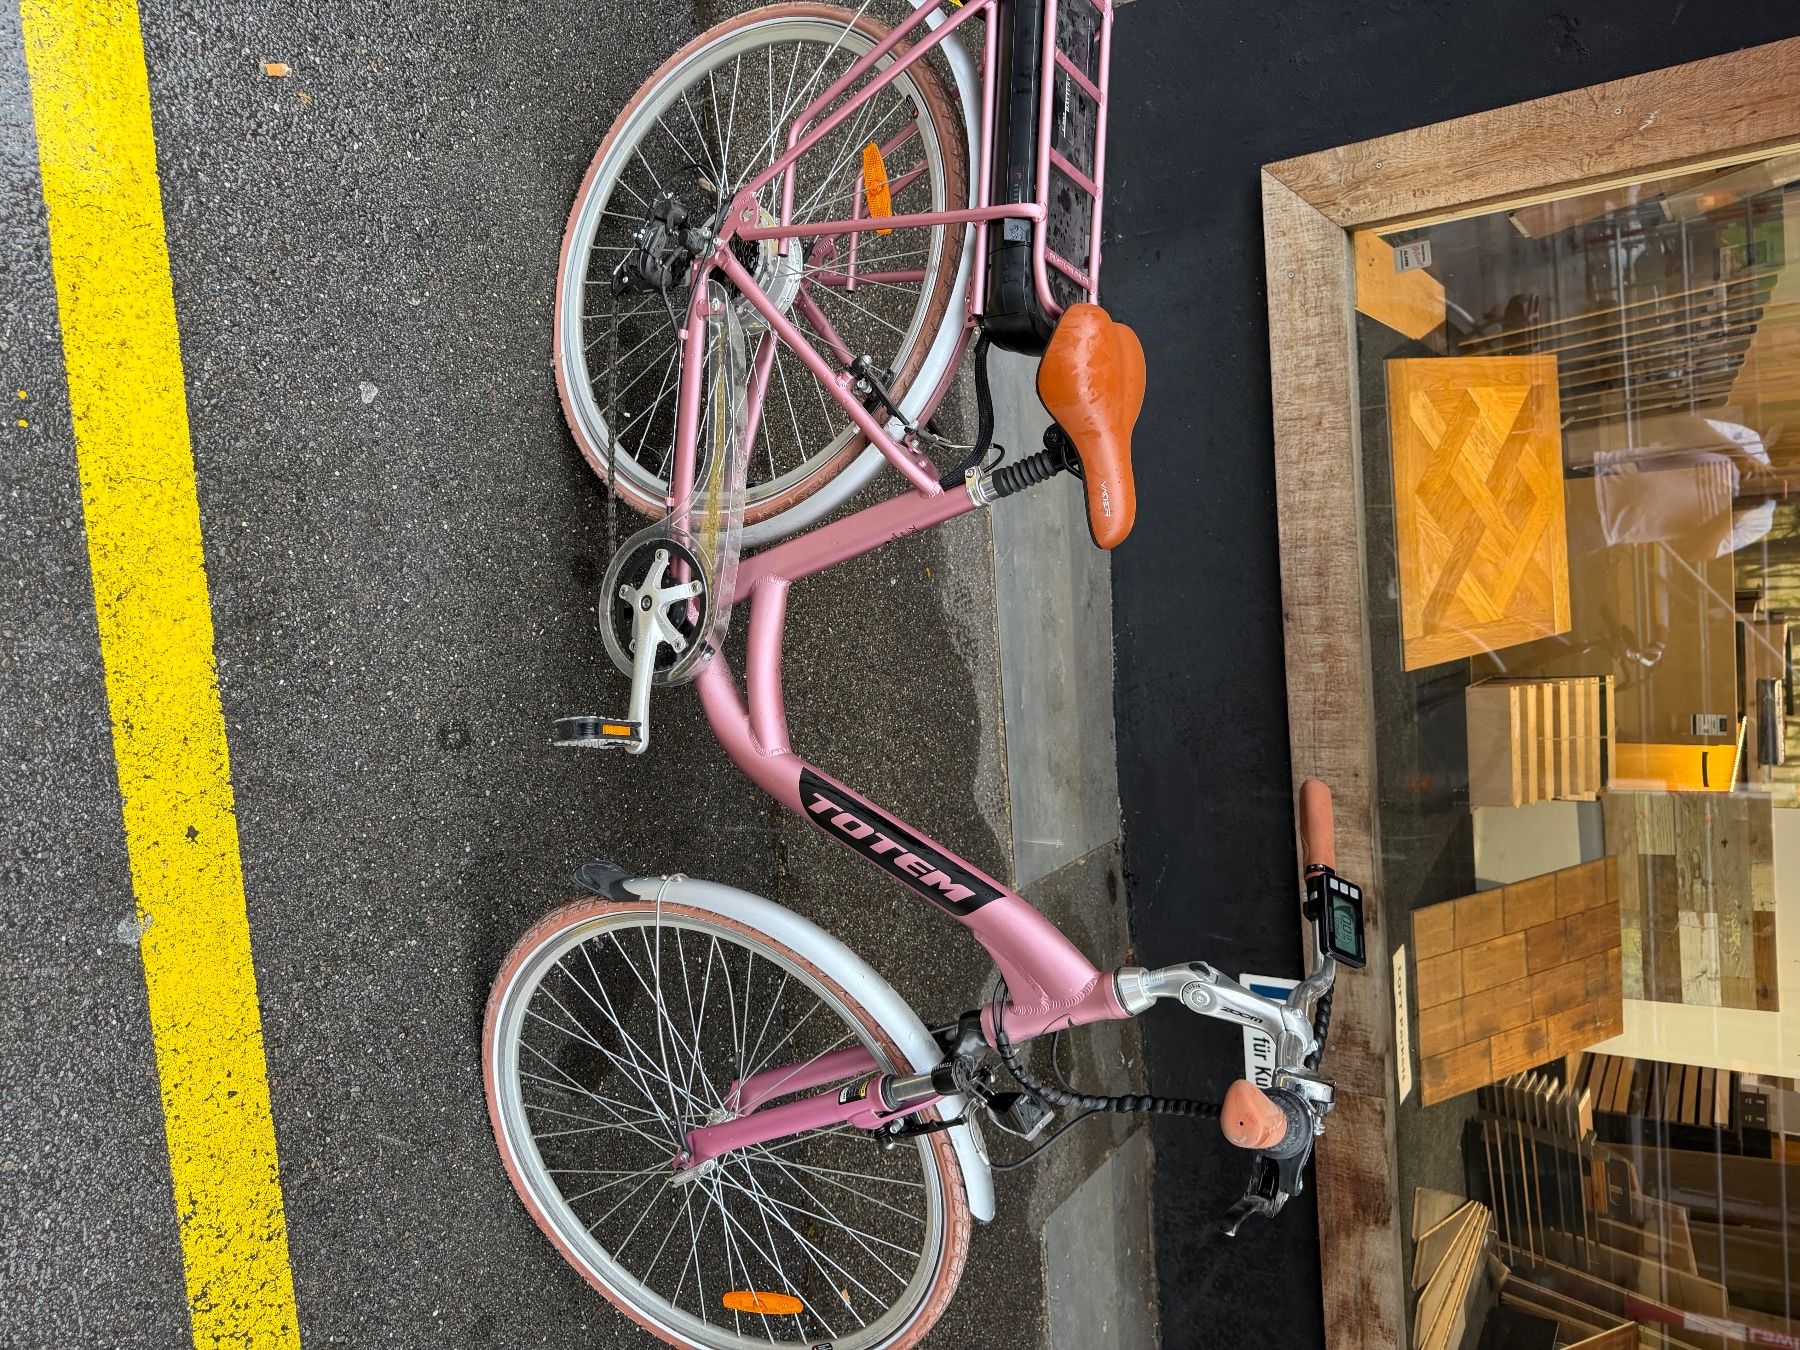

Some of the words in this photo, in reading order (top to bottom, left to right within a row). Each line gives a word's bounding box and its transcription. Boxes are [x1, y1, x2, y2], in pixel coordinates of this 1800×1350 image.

[807, 792, 976, 903] TOTEM
[1253, 1036, 1271, 1061] für
[1254, 1066, 1272, 1087] Ku
